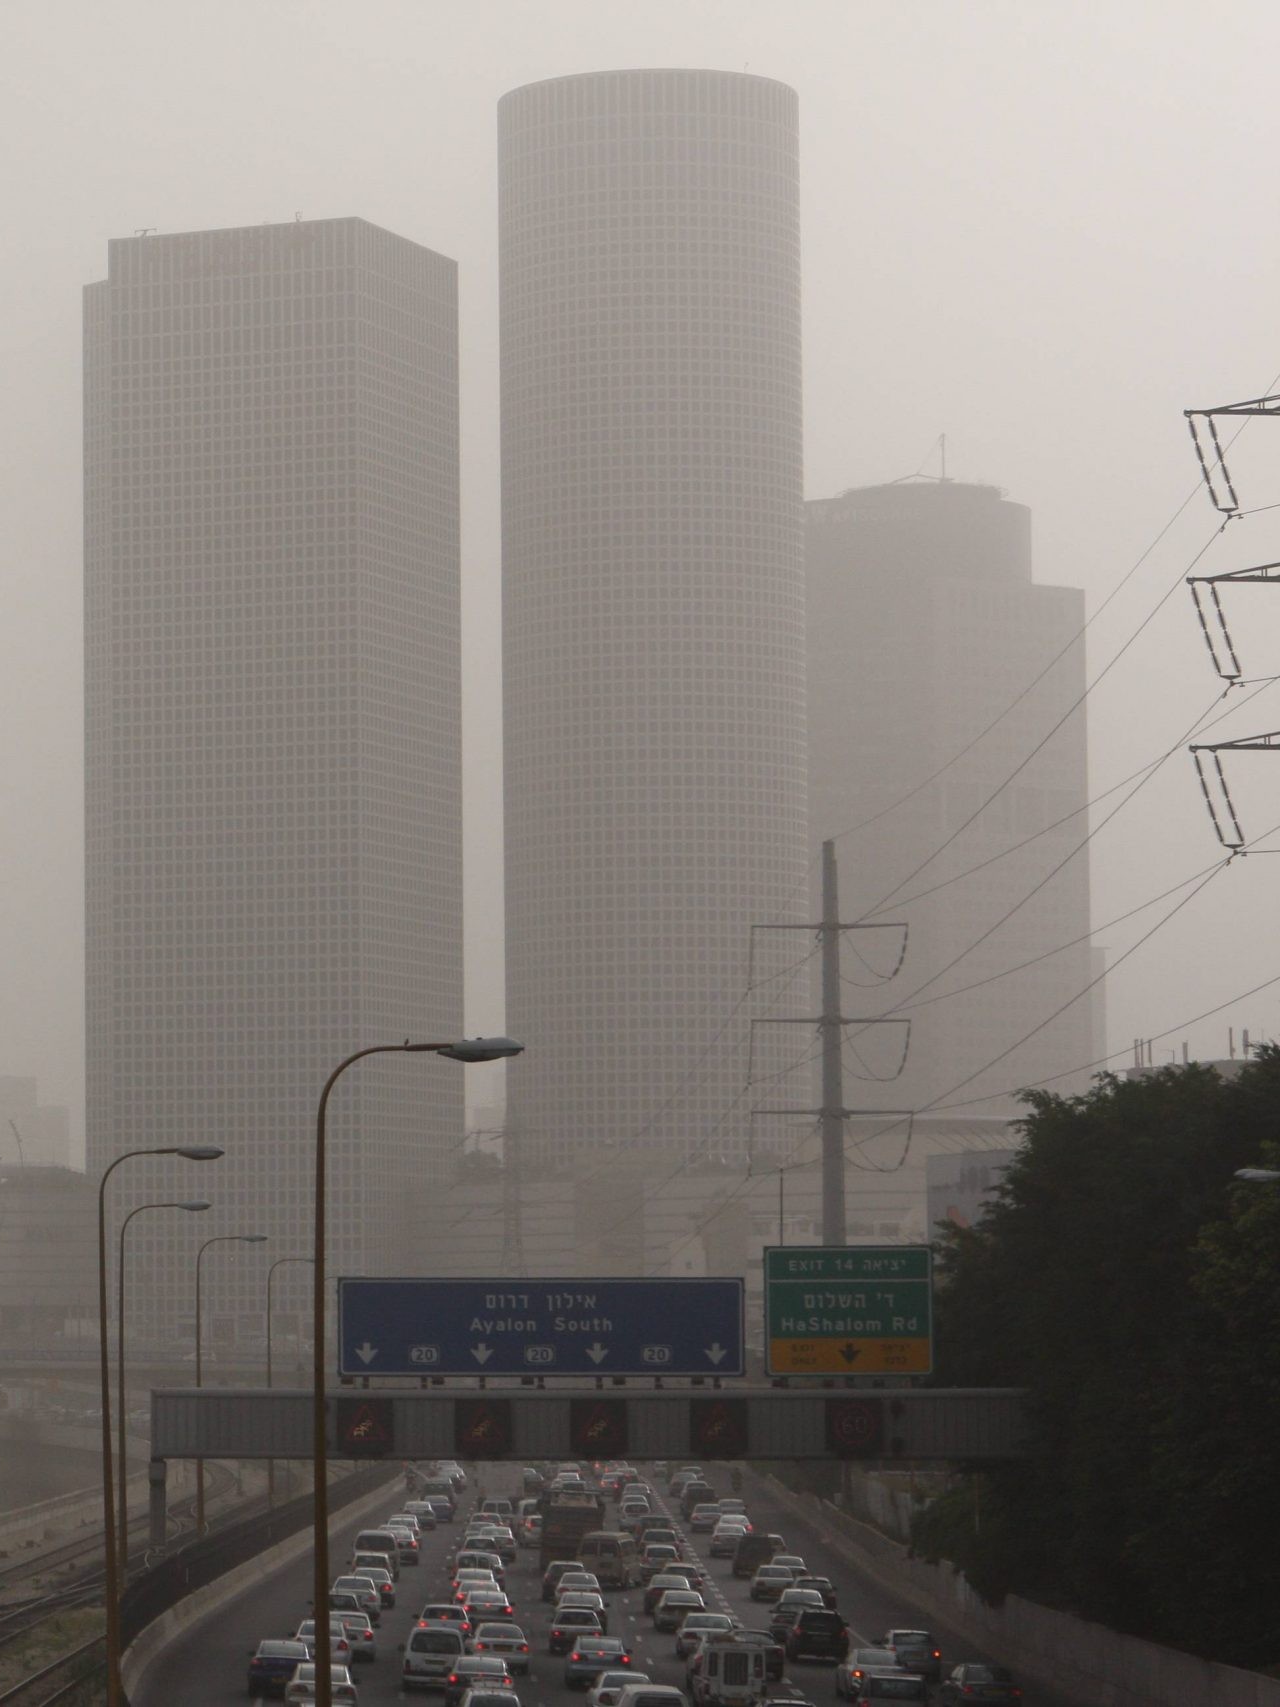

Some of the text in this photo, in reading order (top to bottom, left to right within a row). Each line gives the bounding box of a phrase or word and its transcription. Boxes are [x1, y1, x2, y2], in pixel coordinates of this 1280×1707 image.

[788, 1258, 907, 1271] EXIT 14 יציאה
[486, 1292, 597, 1311] אילון דרום
[804, 1292, 866, 1308] השלום
[470, 1317, 613, 1334] Ayalon South
[781, 1316, 917, 1331] HaShalom Rd
[415, 1348, 434, 1361] 20
[531, 1348, 549, 1361] 20
[647, 1348, 665, 1361] 20
